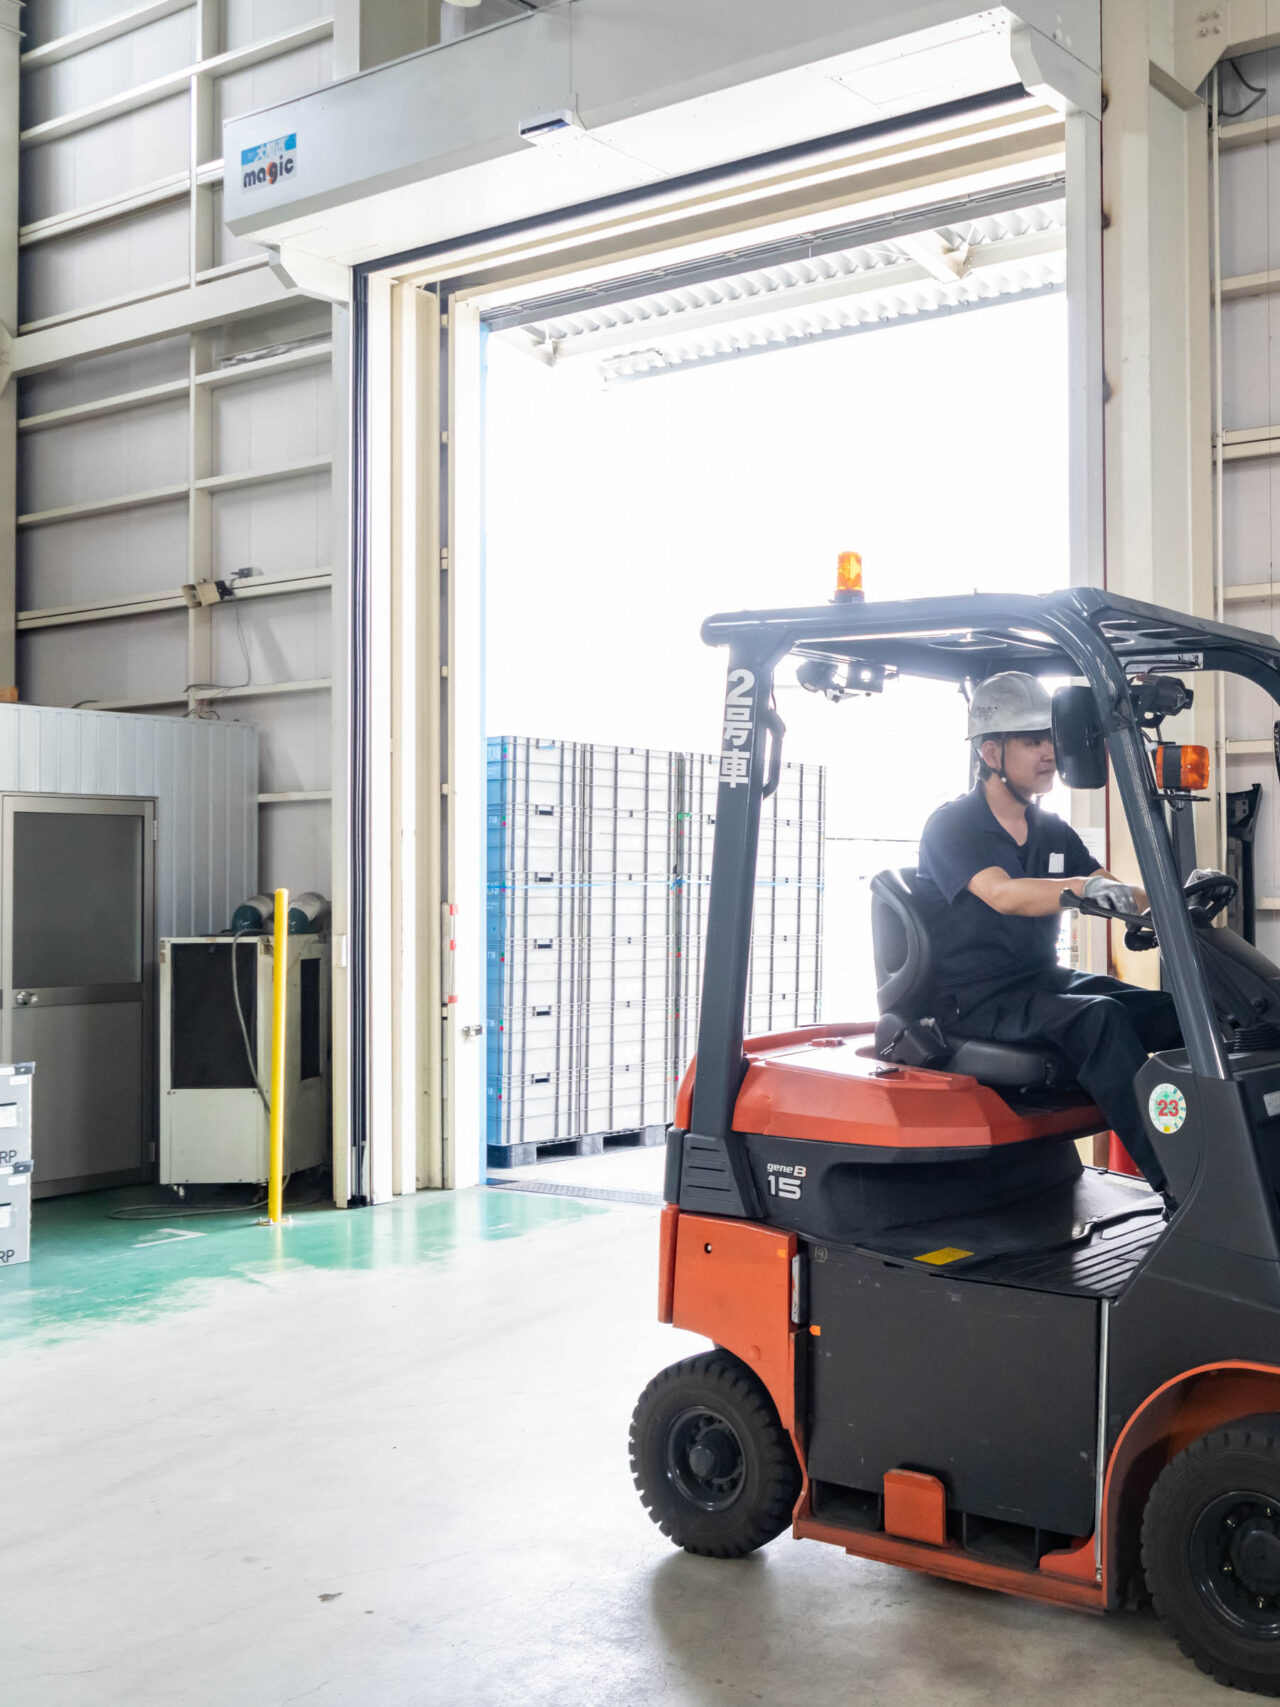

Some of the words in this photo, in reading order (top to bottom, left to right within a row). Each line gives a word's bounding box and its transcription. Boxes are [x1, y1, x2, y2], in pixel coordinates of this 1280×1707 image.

[244, 154, 294, 188] magic
[719, 669, 755, 788] 2号車
[768, 1175, 802, 1200] 15
